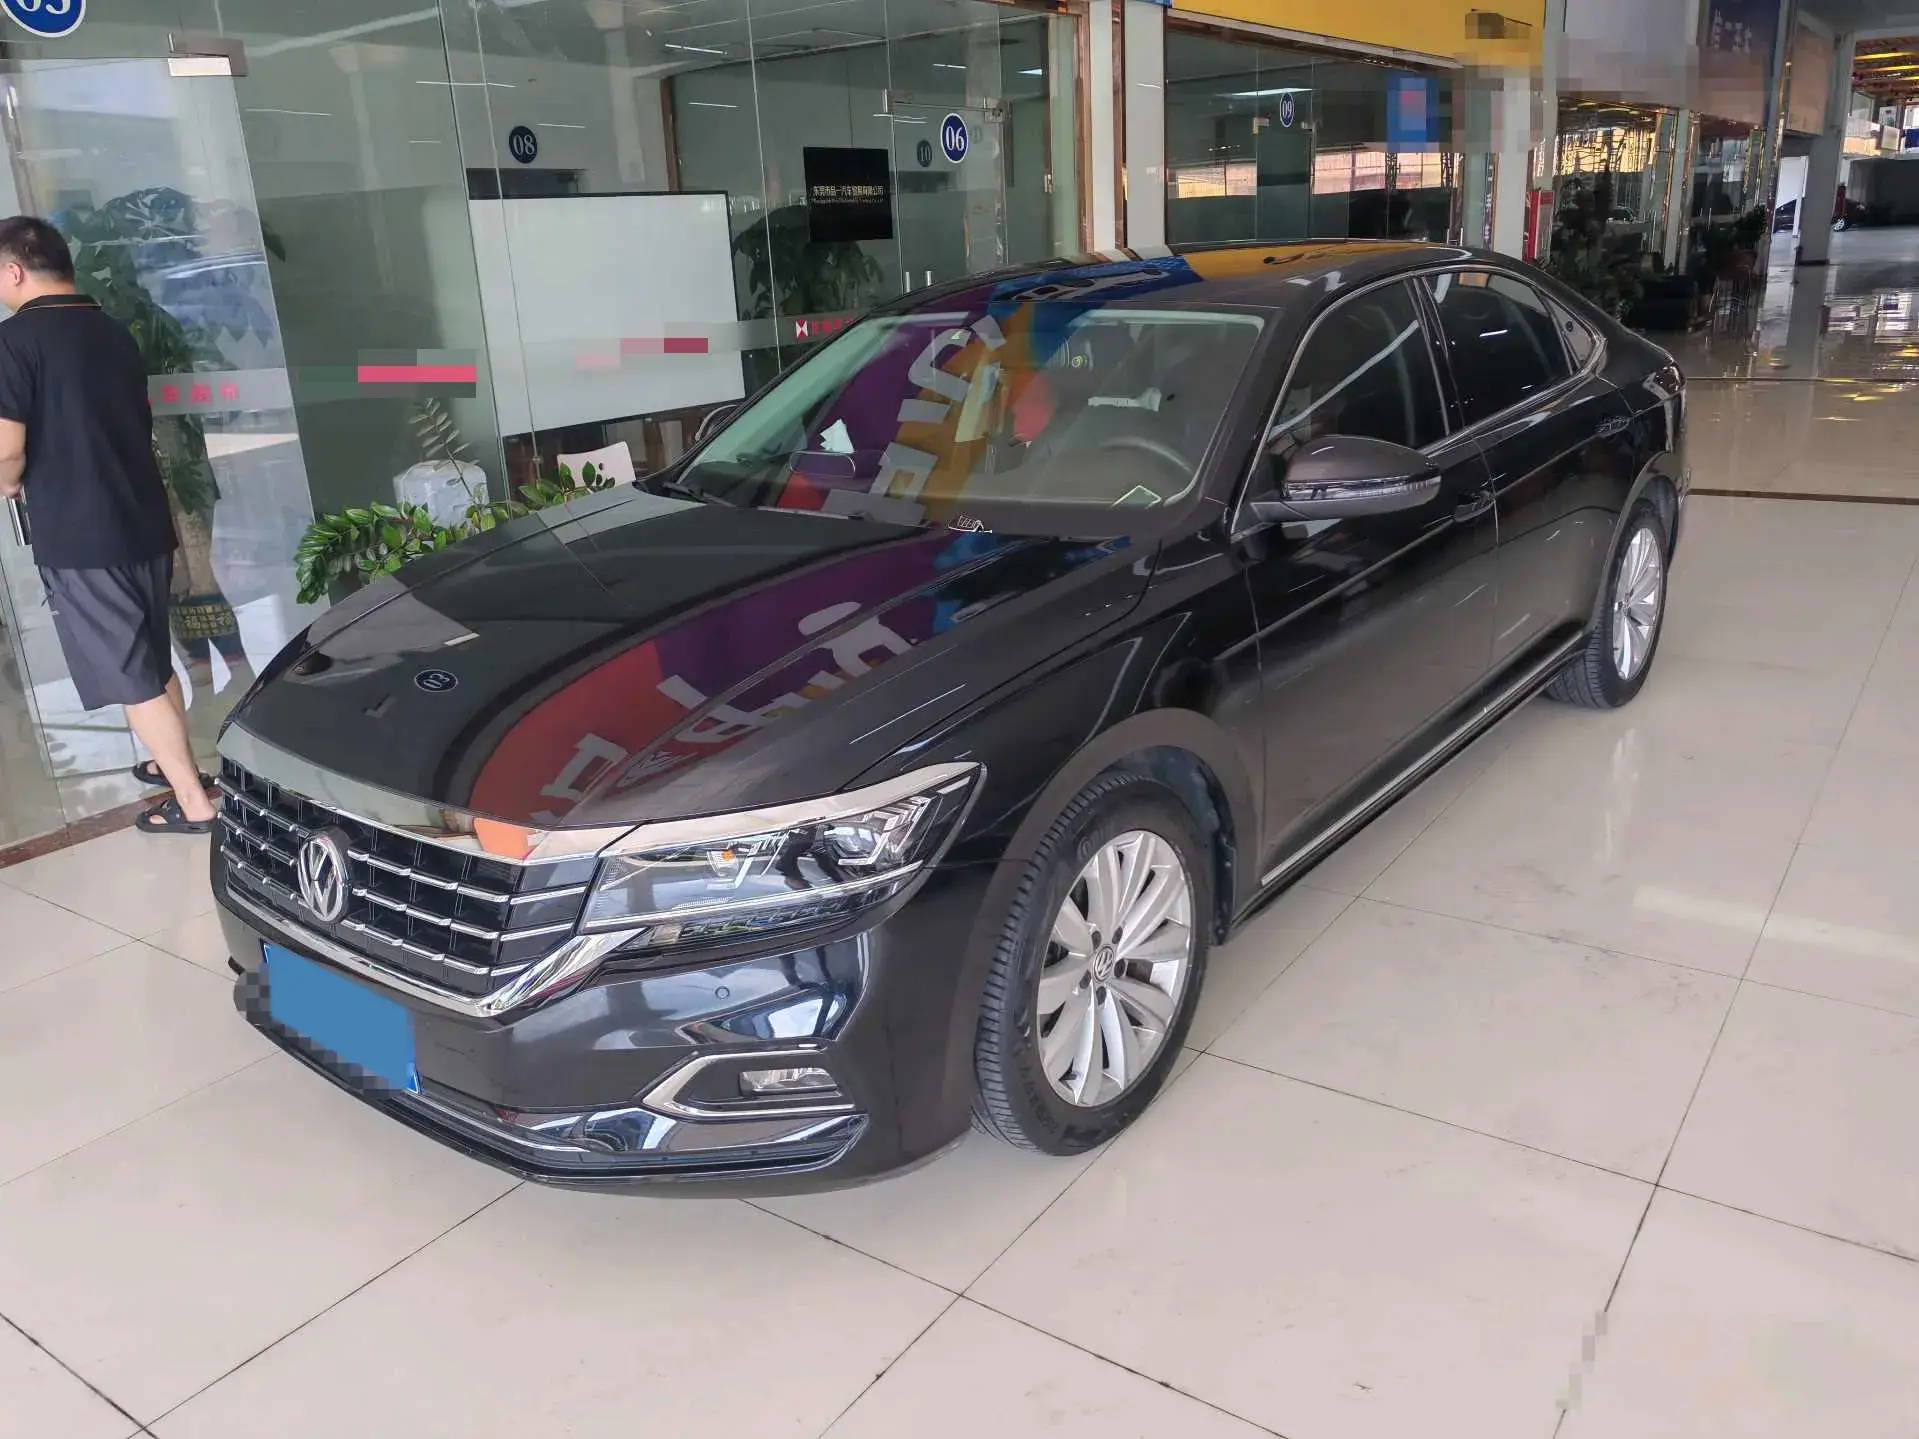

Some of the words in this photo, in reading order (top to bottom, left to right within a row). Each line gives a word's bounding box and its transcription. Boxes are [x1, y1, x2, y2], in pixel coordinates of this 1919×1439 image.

[1282, 100, 1292, 119] 09
[513, 134, 535, 156] 08
[945, 126, 965, 151] 06
